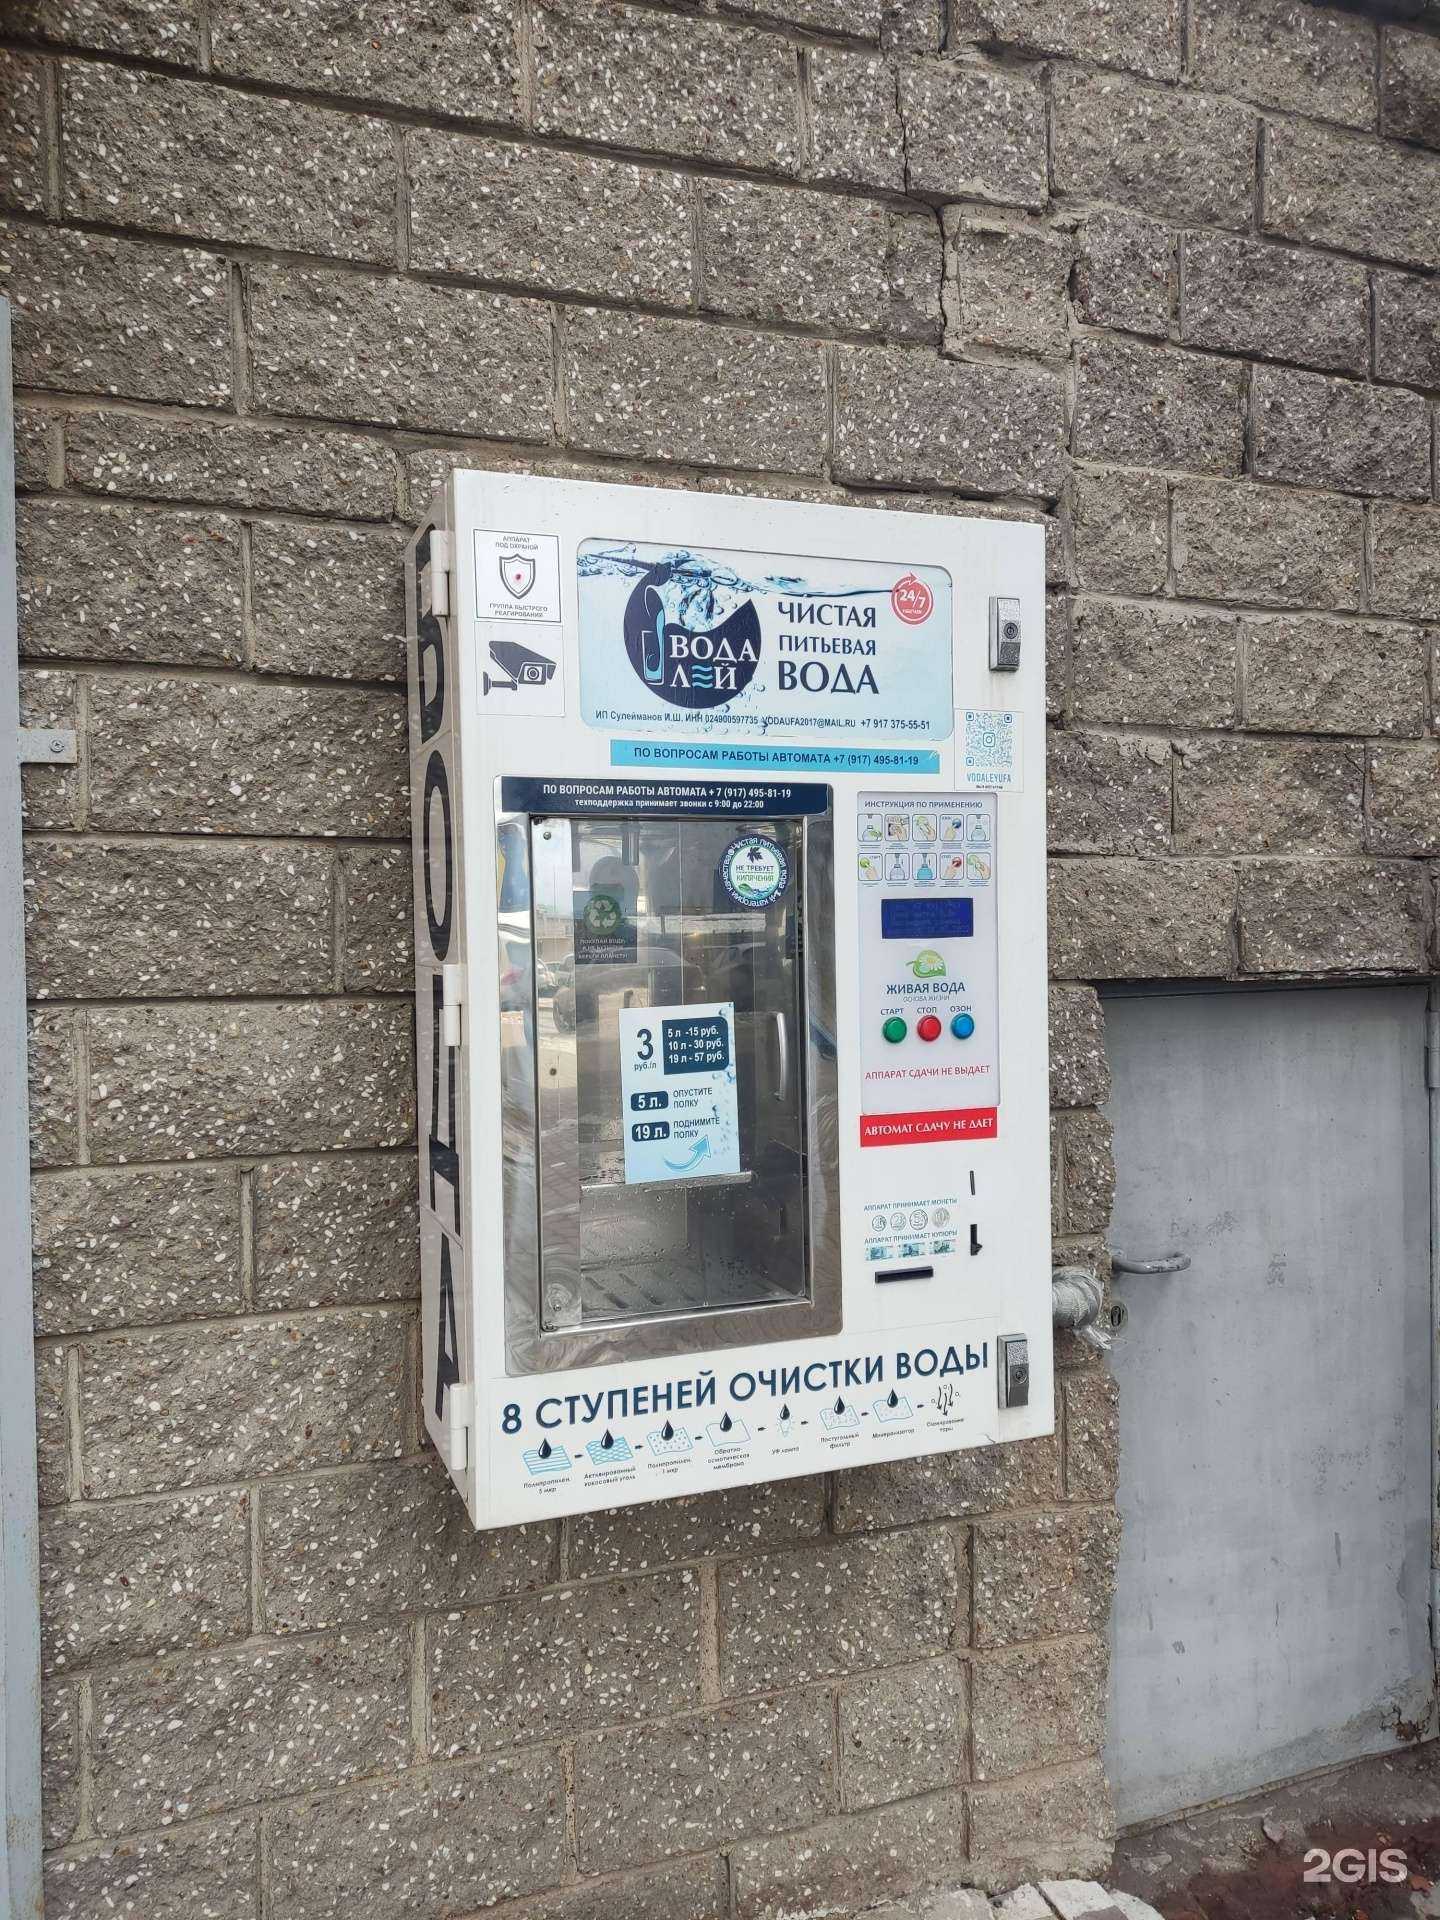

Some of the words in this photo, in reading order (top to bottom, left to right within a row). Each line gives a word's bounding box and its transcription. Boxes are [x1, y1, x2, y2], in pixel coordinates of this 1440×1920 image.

[503, 535, 530, 543] АППАРАТ
[899, 588, 926, 609] 24/7
[777, 601, 877, 628] ЧИСТАЯ
[669, 634, 759, 662] ВОДА
[778, 634, 877, 656] ПИТЬЕВАЯ
[777, 660, 880, 694] ВОДА
[595, 710, 608, 719] ИП
[610, 711, 663, 723] Сулейманов
[664, 712, 684, 722] И.Ш.
[685, 713, 703, 722] ИНН
[860, 718, 871, 728] +7
[873, 719, 888, 728] 917
[890, 719, 931, 730] 375-55-51
[634, 747, 651, 758] ПО
[654, 748, 719, 760] ВОПРОСАМ
[721, 750, 769, 762] РАБОТЫ
[772, 752, 831, 764] АВТОМАТА
[833, 754, 845, 764] +7
[847, 753, 871, 766] (917)
[873, 754, 919, 765] 495-81-19
[967, 773, 1011, 783] VODALEYUFA
[543, 784, 557, 794] ПО
[559, 784, 614, 795] ВОПРОСАМ
[616, 785, 655, 796] РАБОТЫ
[657, 786, 707, 797] АВТОМАТА
[724, 788, 747, 799] (917)
[748, 788, 792, 798] 495-81-19
[574, 799, 634, 809] техподдержка
[635, 800, 678, 809] принимает
[679, 800, 707, 808] звонки
[714, 799, 731, 808] 9:00
[732, 801, 742, 809] до
[743, 800, 764, 808] 22:00
[864, 801, 914, 810] ИНСТРУКЦИЯ
[737, 874, 774, 882] КИПЯЧЕНИЯ
[886, 983, 929, 994] ЖИВАЯ
[933, 982, 965, 995] ВОДА
[880, 1007, 904, 1015] СТАРТ
[917, 1006, 937, 1014] СТОП
[668, 1029, 673, 1038] 5
[674, 1030, 681, 1038] л
[700, 1025, 719, 1037] руб.
[636, 1028, 654, 1061] 3
[668, 1041, 678, 1050] 10
[680, 1042, 687, 1050] л
[694, 1040, 704, 1049] 30
[706, 1038, 724, 1050] руб.
[668, 1054, 679, 1063] 19
[681, 1055, 687, 1063] л
[694, 1052, 704, 1062] 57
[706, 1051, 725, 1063] руб.
[634, 1061, 657, 1072] руб./л
[865, 1069, 907, 1080] АППАРАТ
[908, 1067, 939, 1078] СДАЧИ
[941, 1067, 953, 1075] НЕ
[954, 1065, 991, 1075] ВЫДАЕТ
[673, 1087, 713, 1098] ОПУСТИТЕ
[638, 1095, 646, 1109] 5
[649, 1096, 662, 1108] л.
[673, 1099, 699, 1109] ПОЛКУ
[673, 1116, 720, 1129] ПОДНИМИТЕ
[864, 1123, 913, 1137] АВТОМАТ
[916, 1121, 951, 1133] СДАЧУ
[953, 1120, 966, 1130] НЕ
[969, 1118, 994, 1129] ДАЕТ
[635, 1125, 649, 1140] 19
[653, 1126, 667, 1138] л.
[673, 1130, 699, 1140] ПОЛКУ
[864, 1204, 891, 1212] АППАРАТ
[892, 1200, 930, 1209] ПРИНИМАЕТ
[864, 1237, 892, 1245] АППАРАТ
[893, 1232, 931, 1242] ПРИНИМАЕТ
[931, 1230, 958, 1238] КУПЮРЫ
[501, 1403, 522, 1435] 8
[535, 1369, 717, 1430] СТУПЕНЕЙ
[729, 1355, 884, 1402] ОЧИСТКИ
[896, 1342, 988, 1380] ВОДЫ
